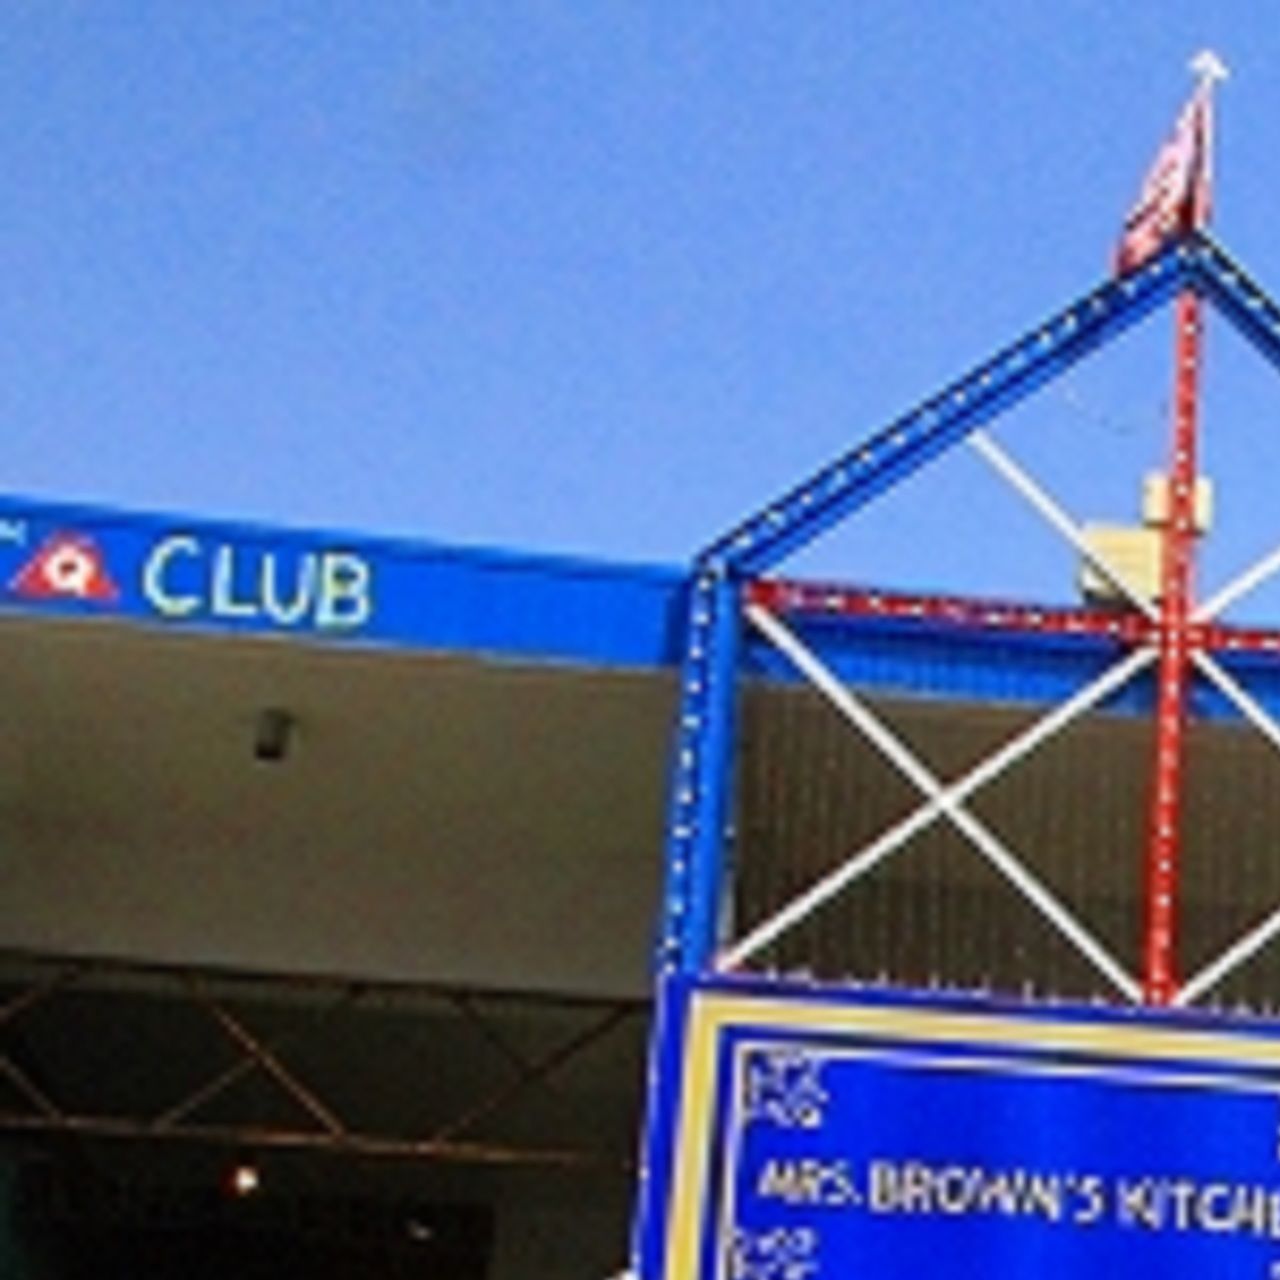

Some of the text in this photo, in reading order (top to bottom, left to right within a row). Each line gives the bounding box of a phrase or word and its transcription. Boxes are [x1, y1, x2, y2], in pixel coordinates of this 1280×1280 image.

[142, 535, 373, 630] CLUB
[757, 1158, 862, 1206] MRS.
[868, 1161, 1102, 1225] BROWN'S
